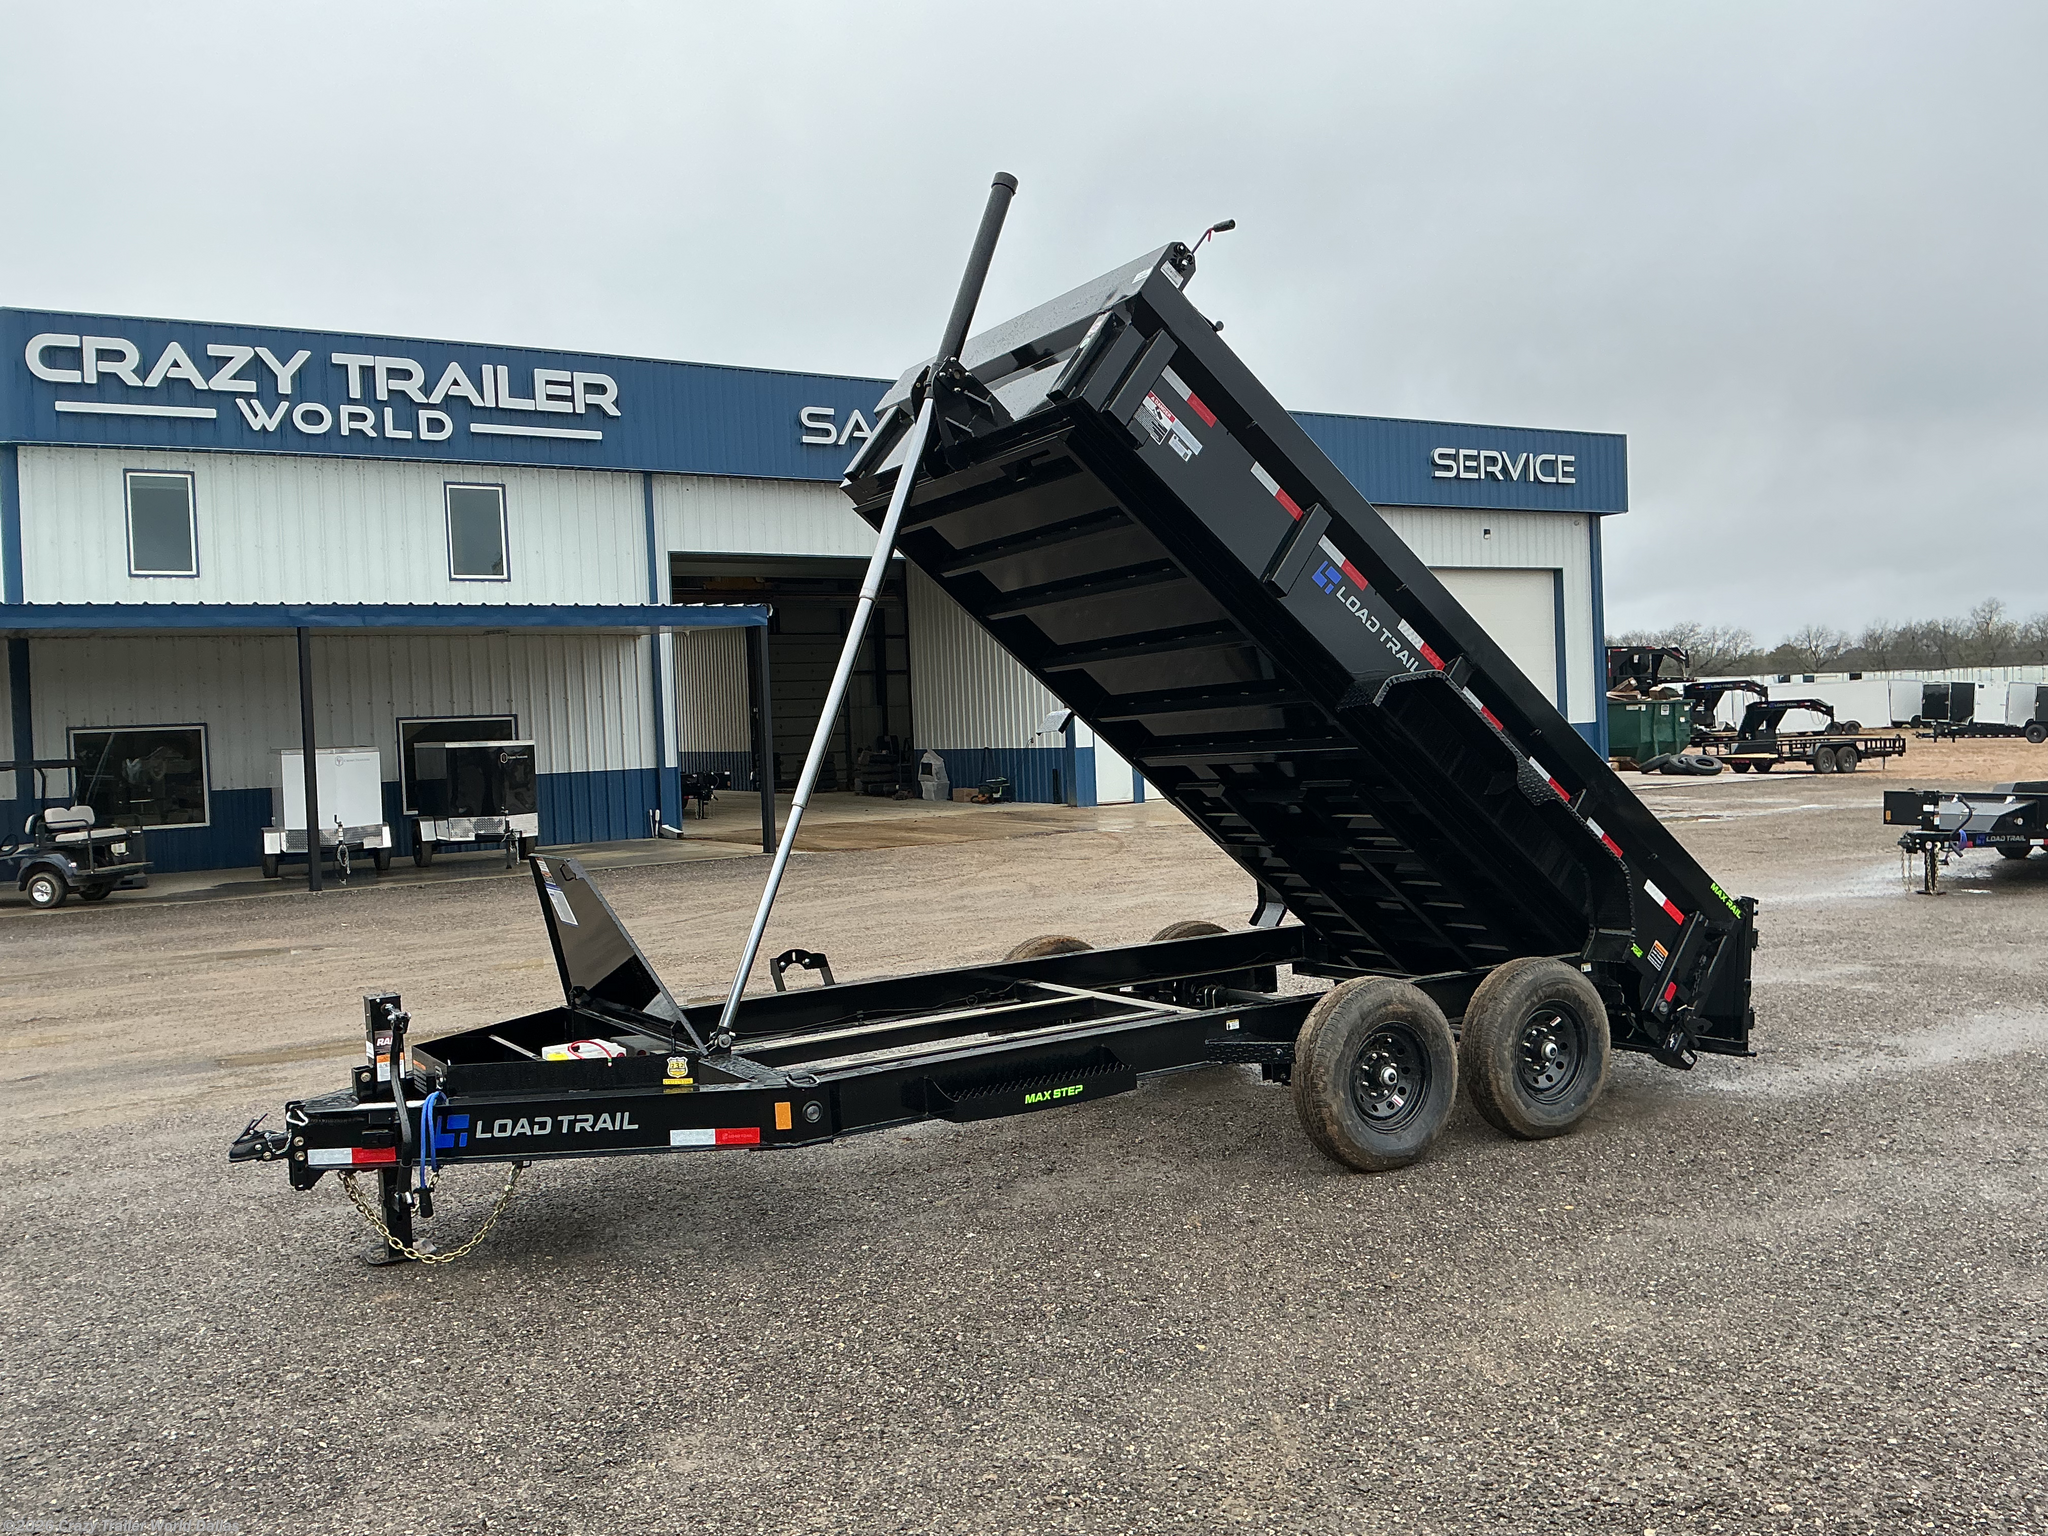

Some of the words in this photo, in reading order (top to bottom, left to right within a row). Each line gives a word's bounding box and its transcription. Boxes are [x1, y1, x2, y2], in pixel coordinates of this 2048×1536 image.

[25, 332, 311, 394] CRAZY
[331, 351, 622, 418] TRAILER
[235, 397, 454, 442] WORLD
[1431, 447, 1576, 484] SERVICE
[1335, 585, 1381, 634] LOAD
[1379, 627, 1421, 673] TRAIL
[1986, 834, 2006, 842] LOAD
[2006, 834, 2027, 842] TRAIL
[1709, 882, 1726, 903] MAX
[1725, 898, 1743, 920] RAIL
[376, 1037, 393, 1047] RA
[1024, 1089, 1052, 1105] MAX
[1052, 1084, 1084, 1100] STEP
[475, 1115, 553, 1139] LOAD
[556, 1111, 639, 1134] TRAIL
